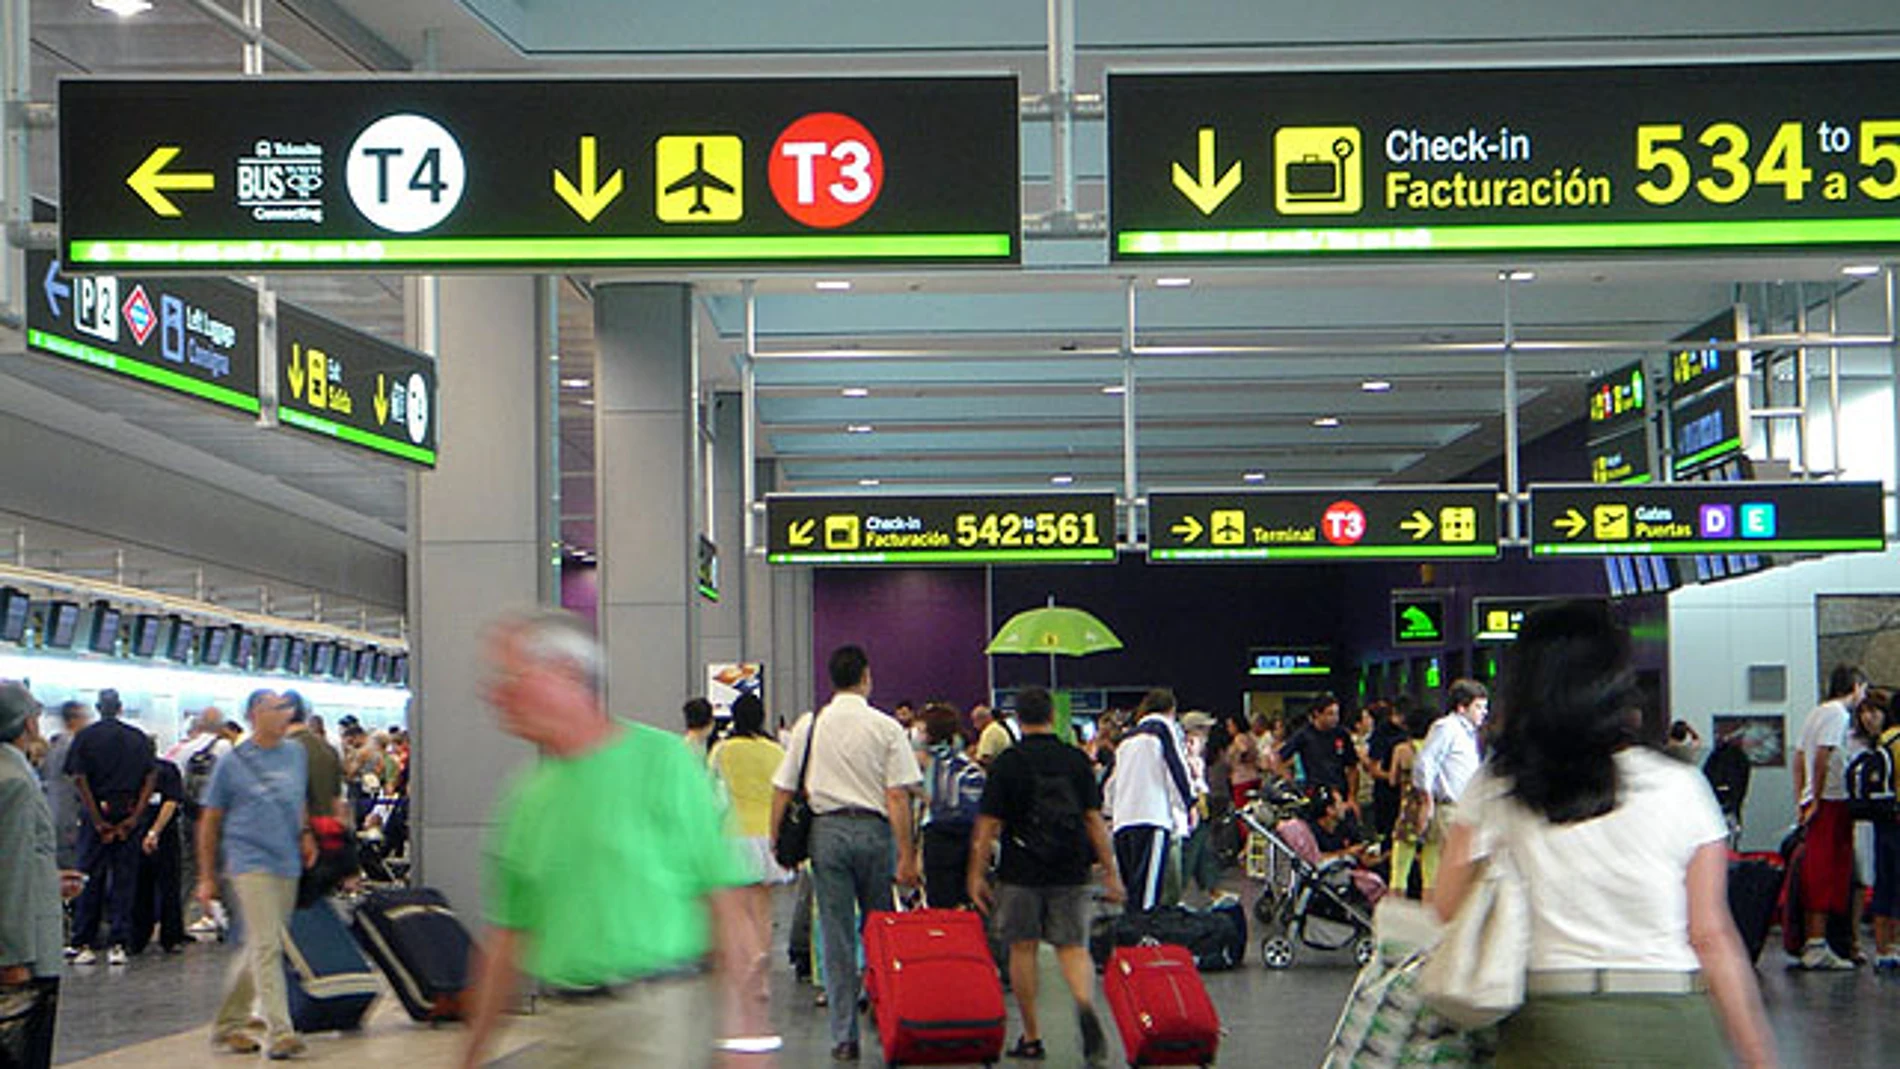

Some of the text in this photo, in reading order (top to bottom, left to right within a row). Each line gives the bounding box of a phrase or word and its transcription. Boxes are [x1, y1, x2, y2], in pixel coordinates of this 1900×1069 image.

[1385, 128, 1531, 161] Check-in
[1817, 120, 1851, 153] to
[362, 147, 448, 203] T4
[782, 140, 873, 204] T3
[1635, 121, 1813, 205] 534
[237, 164, 285, 199] BUS
[1386, 166, 1611, 209] Facturación
[1822, 171, 1848, 200] a
[866, 515, 921, 530] Check-in
[956, 511, 1021, 546] 542
[1035, 511, 1099, 545] 561
[1252, 526, 1316, 543] Terminal
[1326, 510, 1364, 539] T3
[1634, 521, 1693, 538] Puertas
[1705, 509, 1765, 533] D E
